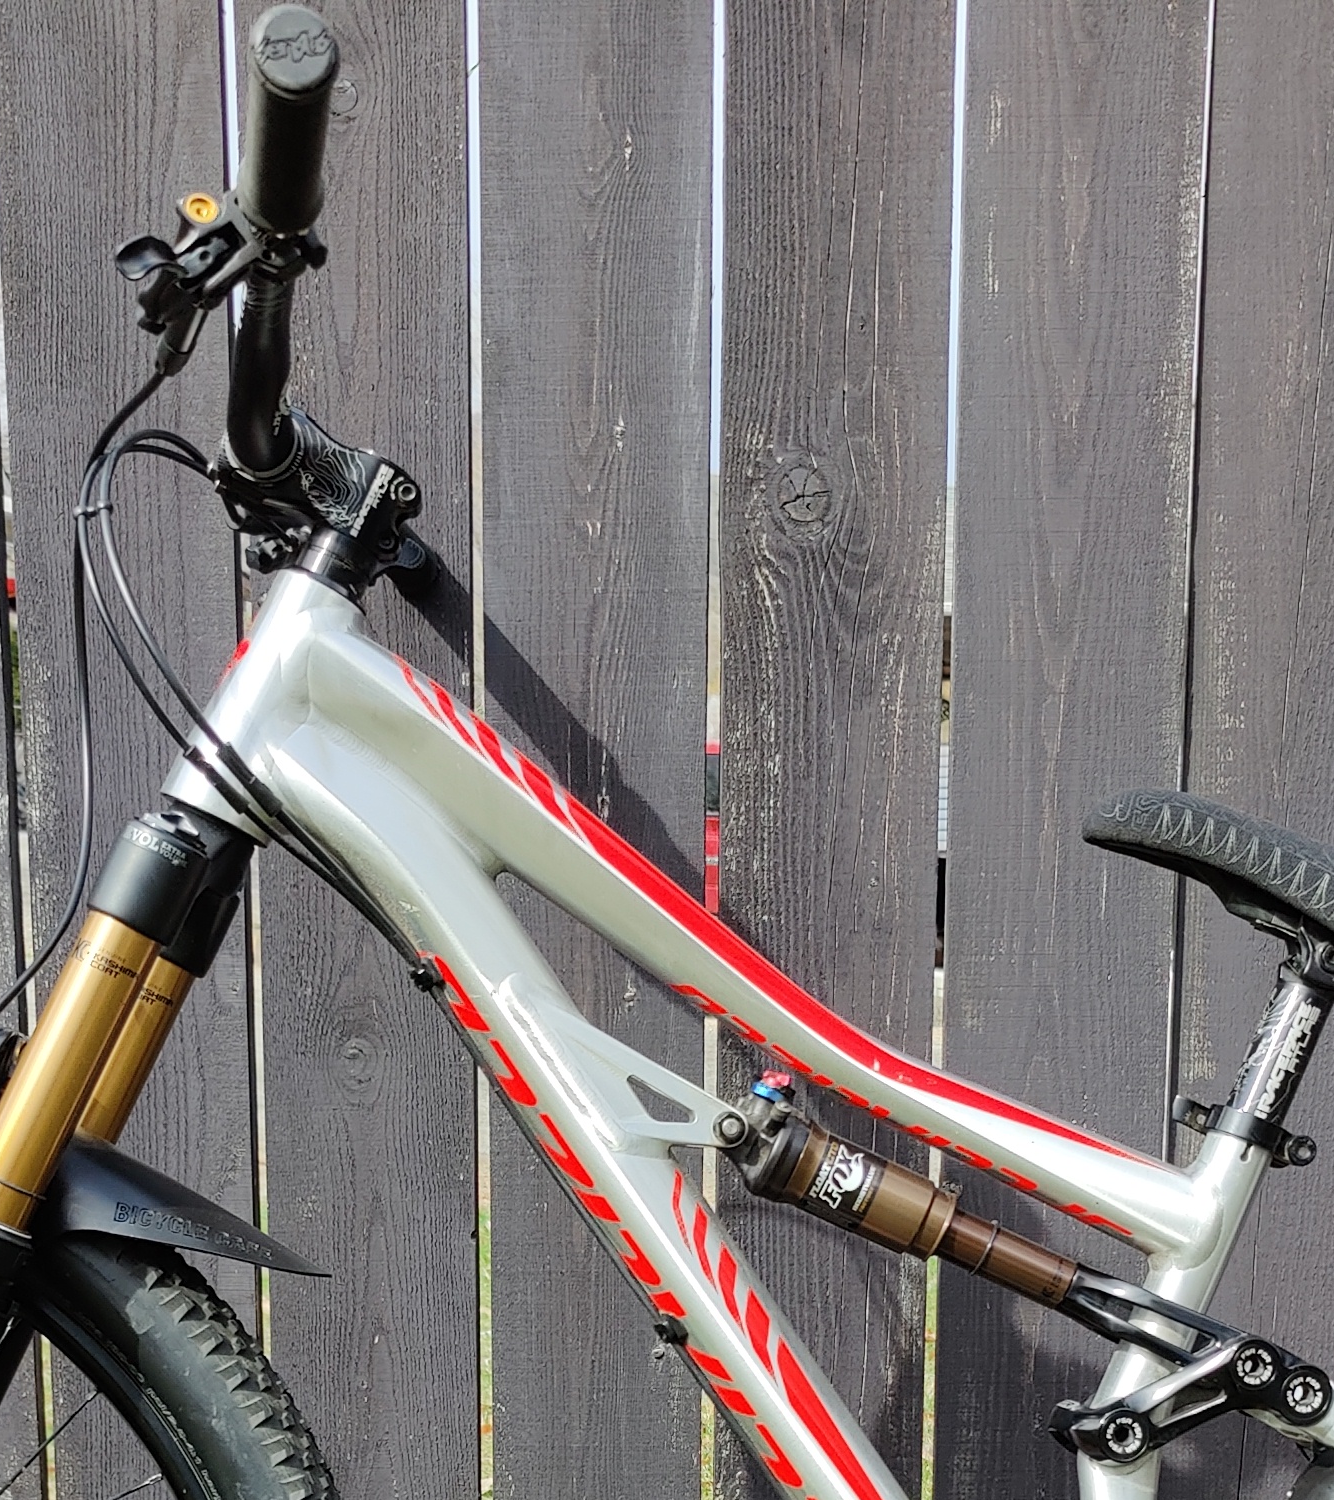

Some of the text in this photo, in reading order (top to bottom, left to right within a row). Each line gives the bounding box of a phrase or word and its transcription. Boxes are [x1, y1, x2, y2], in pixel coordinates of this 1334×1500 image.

[808, 1161, 831, 1197] FLOAT
[818, 1144, 864, 1209] FOX
[113, 1202, 210, 1241] BICYCLE
